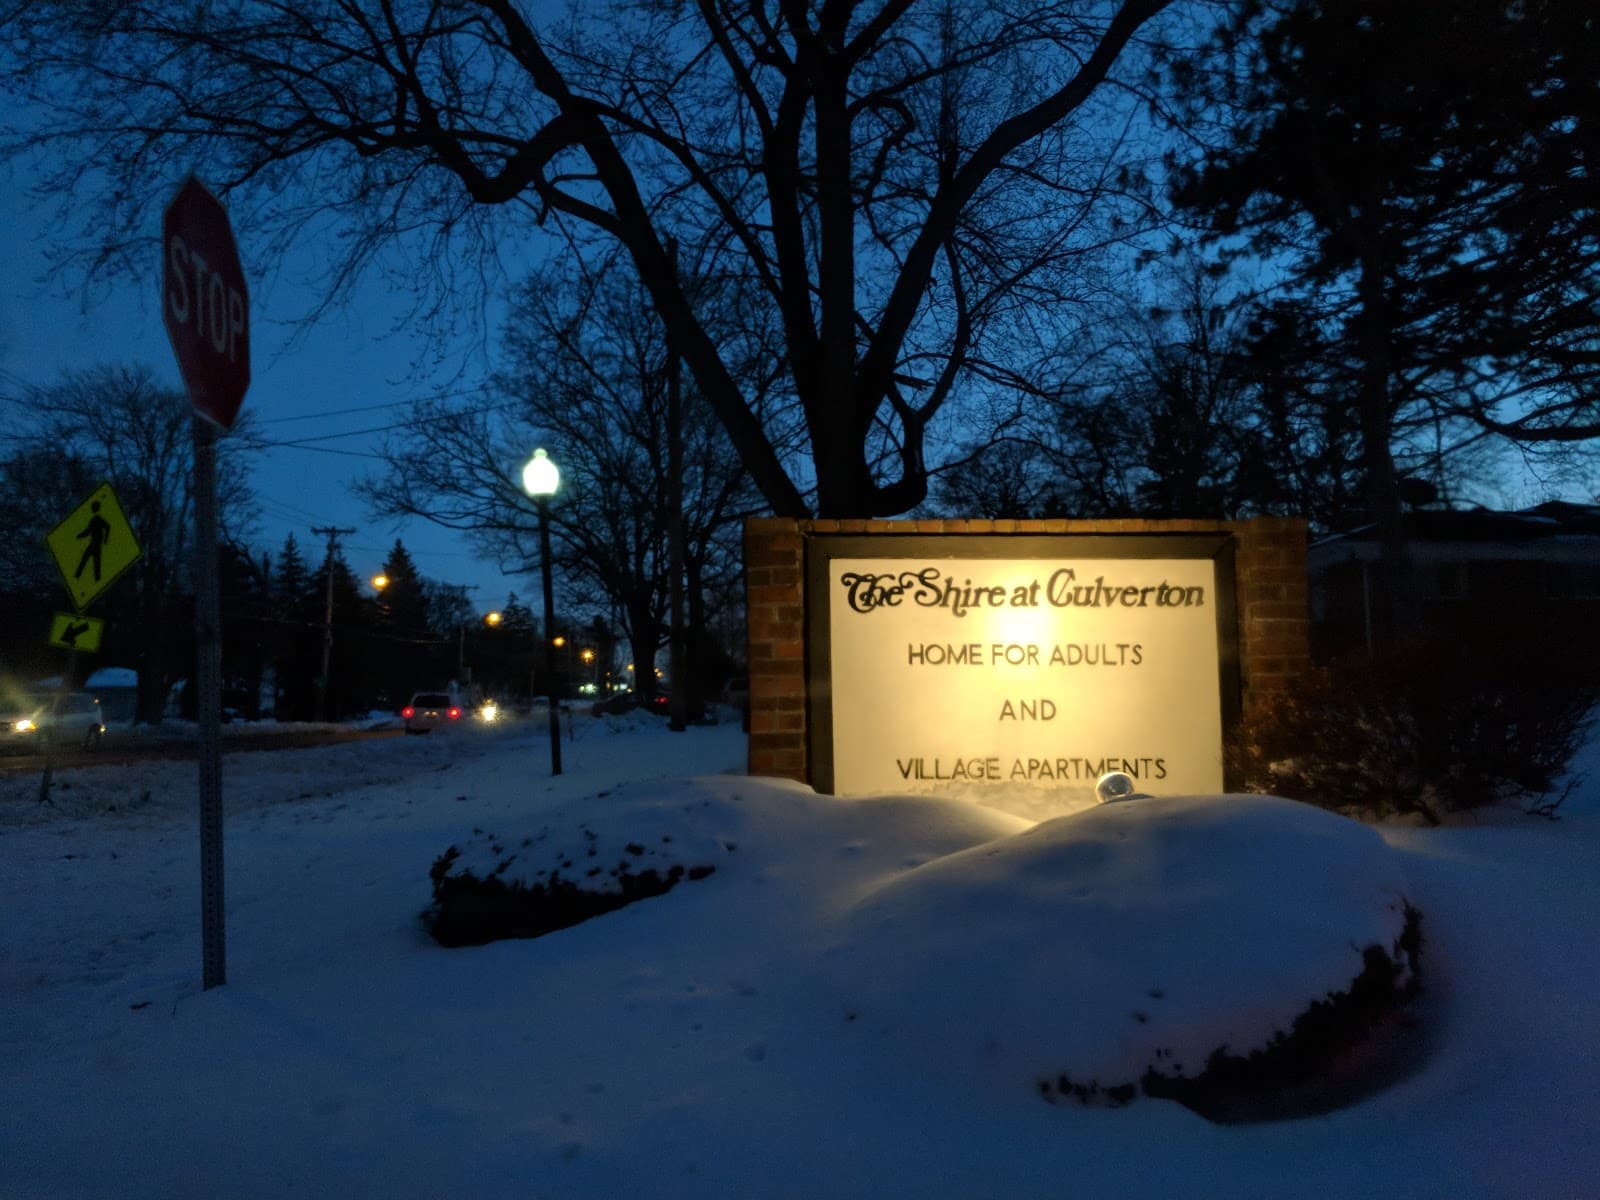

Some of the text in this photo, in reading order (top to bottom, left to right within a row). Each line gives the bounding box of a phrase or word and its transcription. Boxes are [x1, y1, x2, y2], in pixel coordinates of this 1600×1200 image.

[170, 235, 245, 363] STOP
[841, 567, 1204, 617] The Shire at Culverton
[908, 643, 1143, 666] HOME FOR ADULTS
[999, 699, 1057, 721] AND
[896, 757, 1001, 780] VILLAGE
